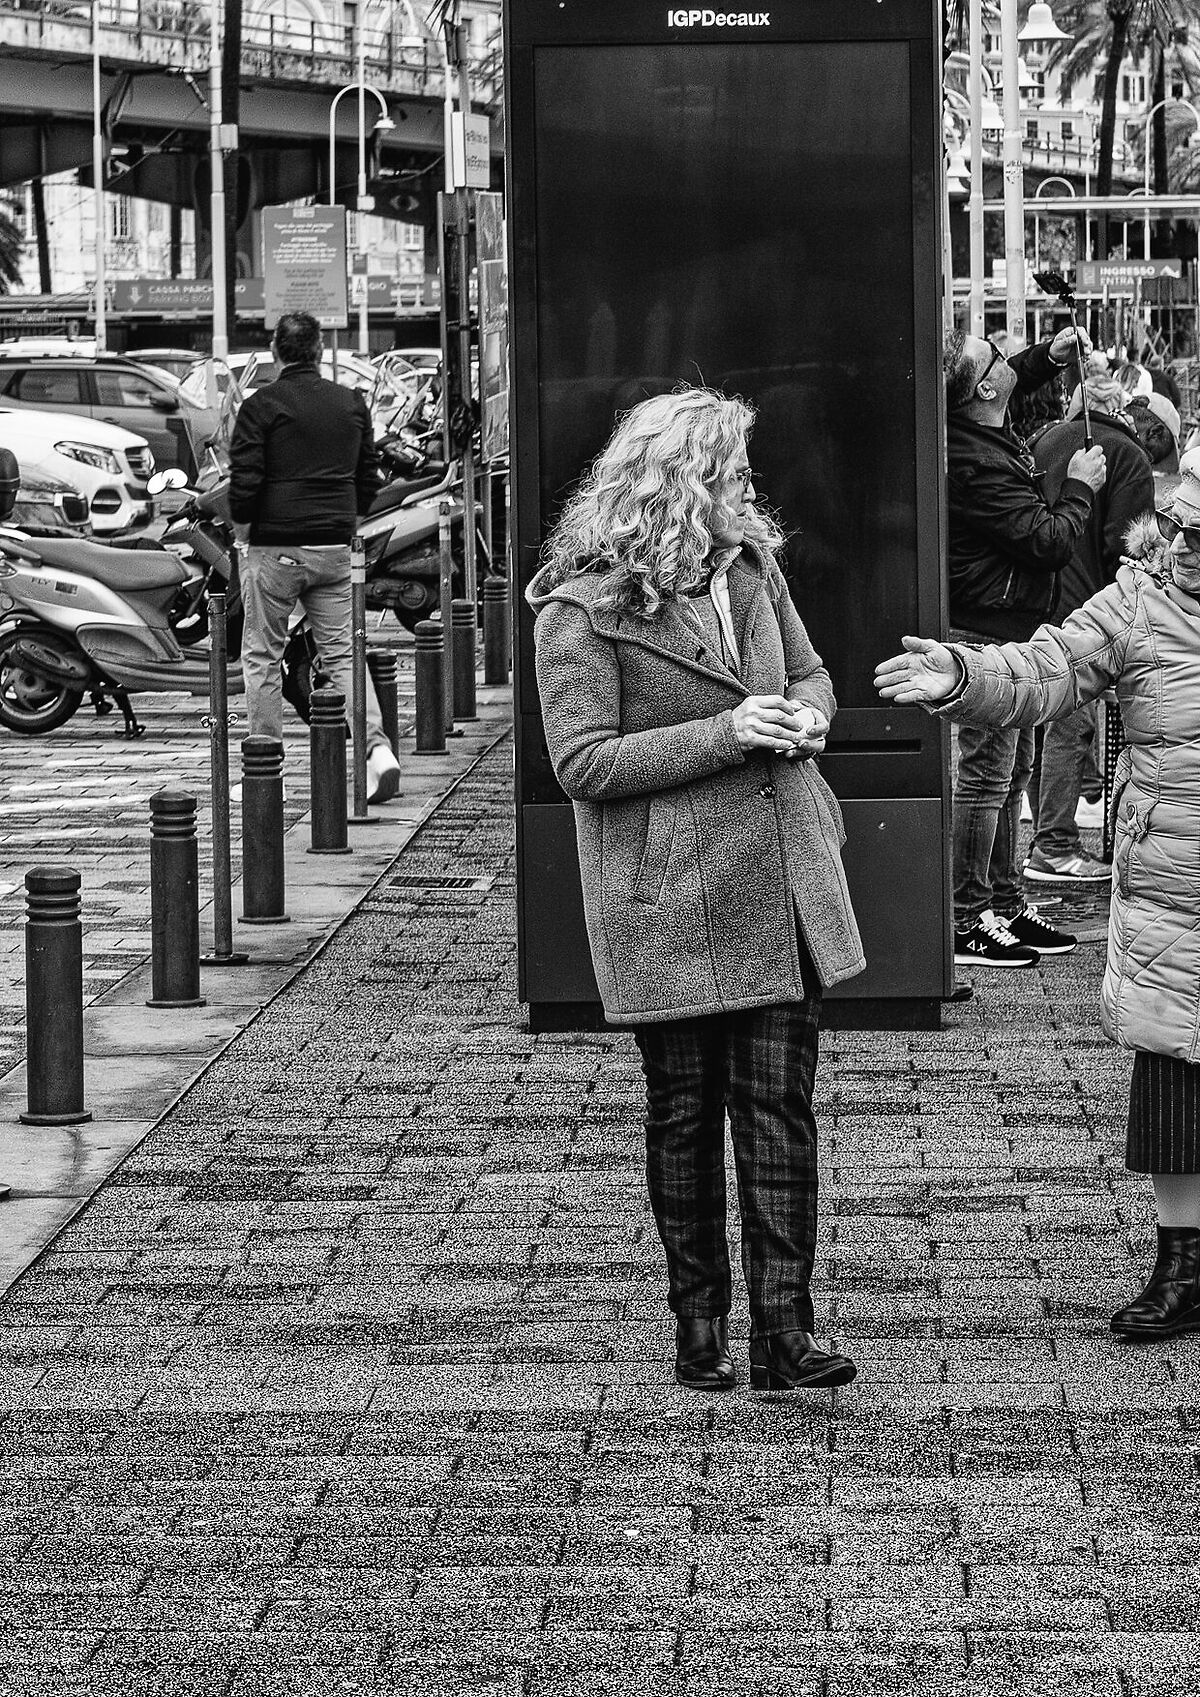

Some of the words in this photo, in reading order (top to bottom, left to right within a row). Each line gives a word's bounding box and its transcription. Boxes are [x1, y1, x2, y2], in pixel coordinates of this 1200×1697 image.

[667, 10, 771, 27] IGPDecaux
[1100, 265, 1155, 276] INGRESSO
[149, 285, 180, 294] CASSA
[31, 577, 51, 585] FLY
